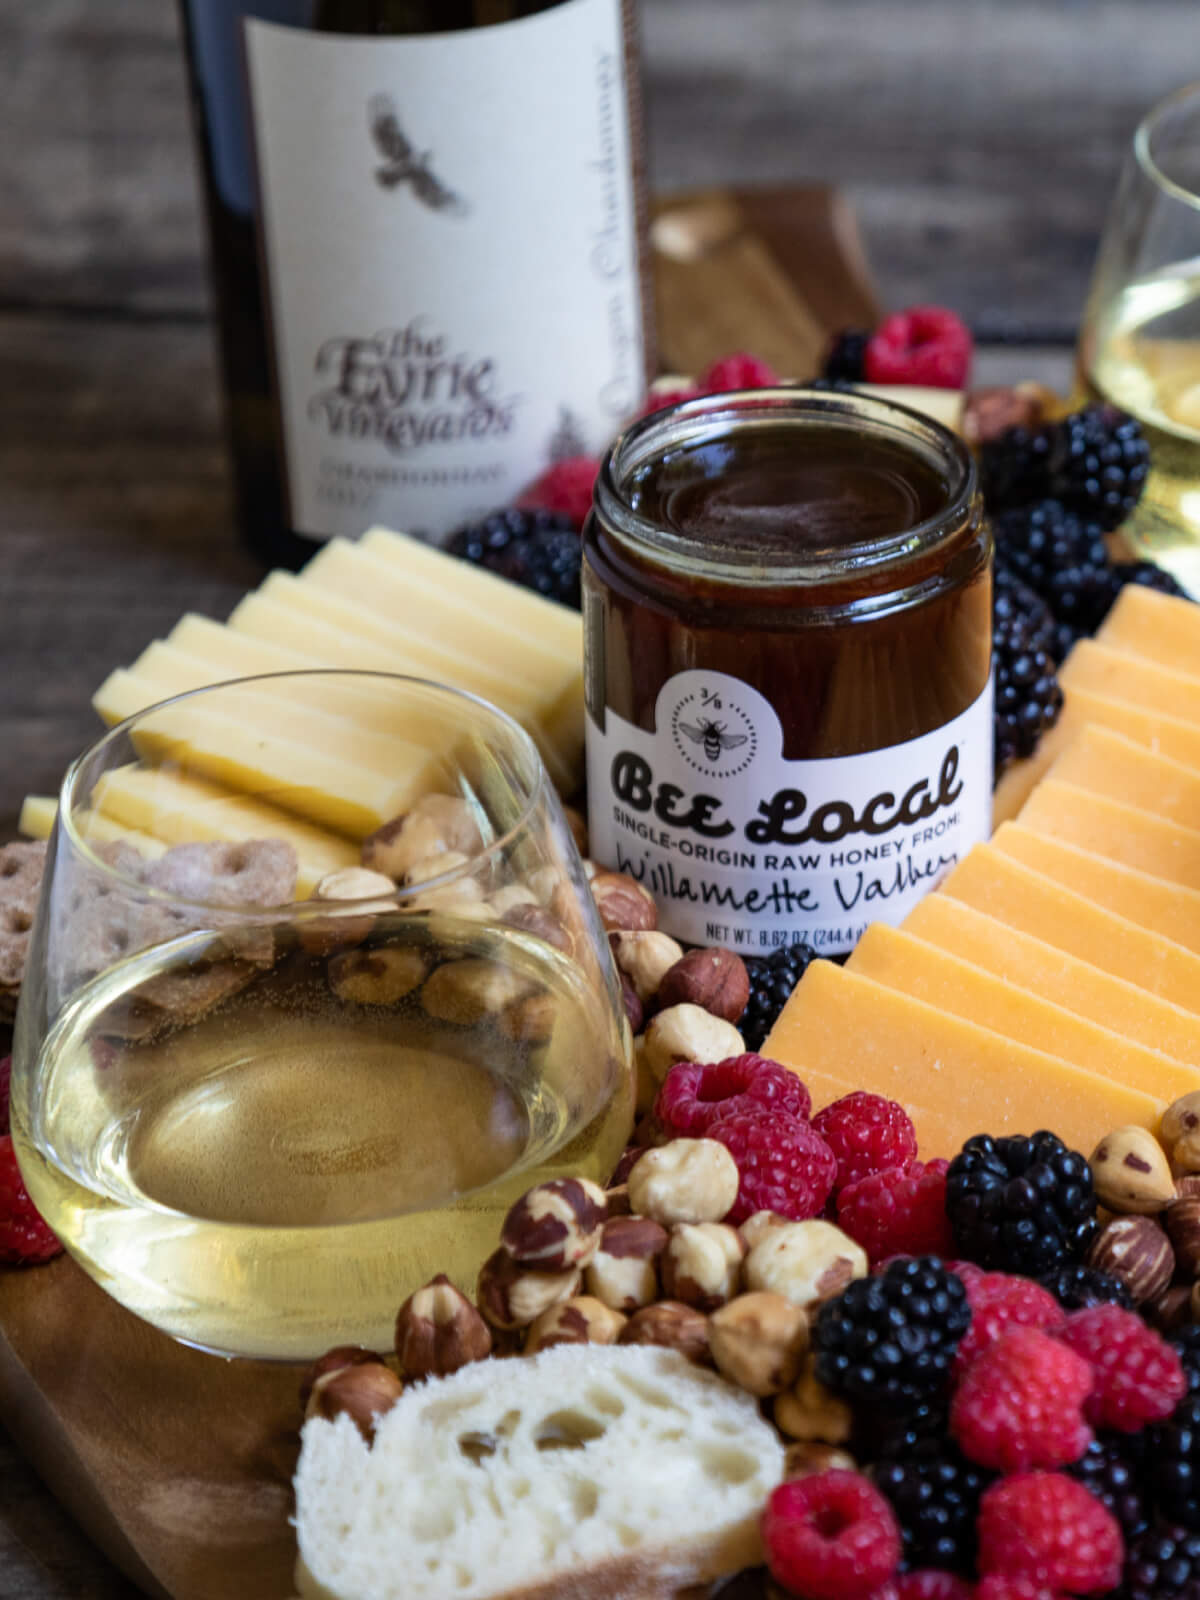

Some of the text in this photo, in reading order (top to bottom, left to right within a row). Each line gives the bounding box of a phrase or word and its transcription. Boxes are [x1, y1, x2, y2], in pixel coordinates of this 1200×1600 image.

[744, 745, 964, 846] Local
[613, 805, 756, 869] SINGLE-ORIGIN
[764, 854, 820, 871] RAW
[831, 837, 905, 868] HONEY
[616, 840, 819, 914] Willamette
[706, 922, 728, 940] NET
[759, 930, 786, 947] 8.62
[792, 930, 808, 945] OZ
